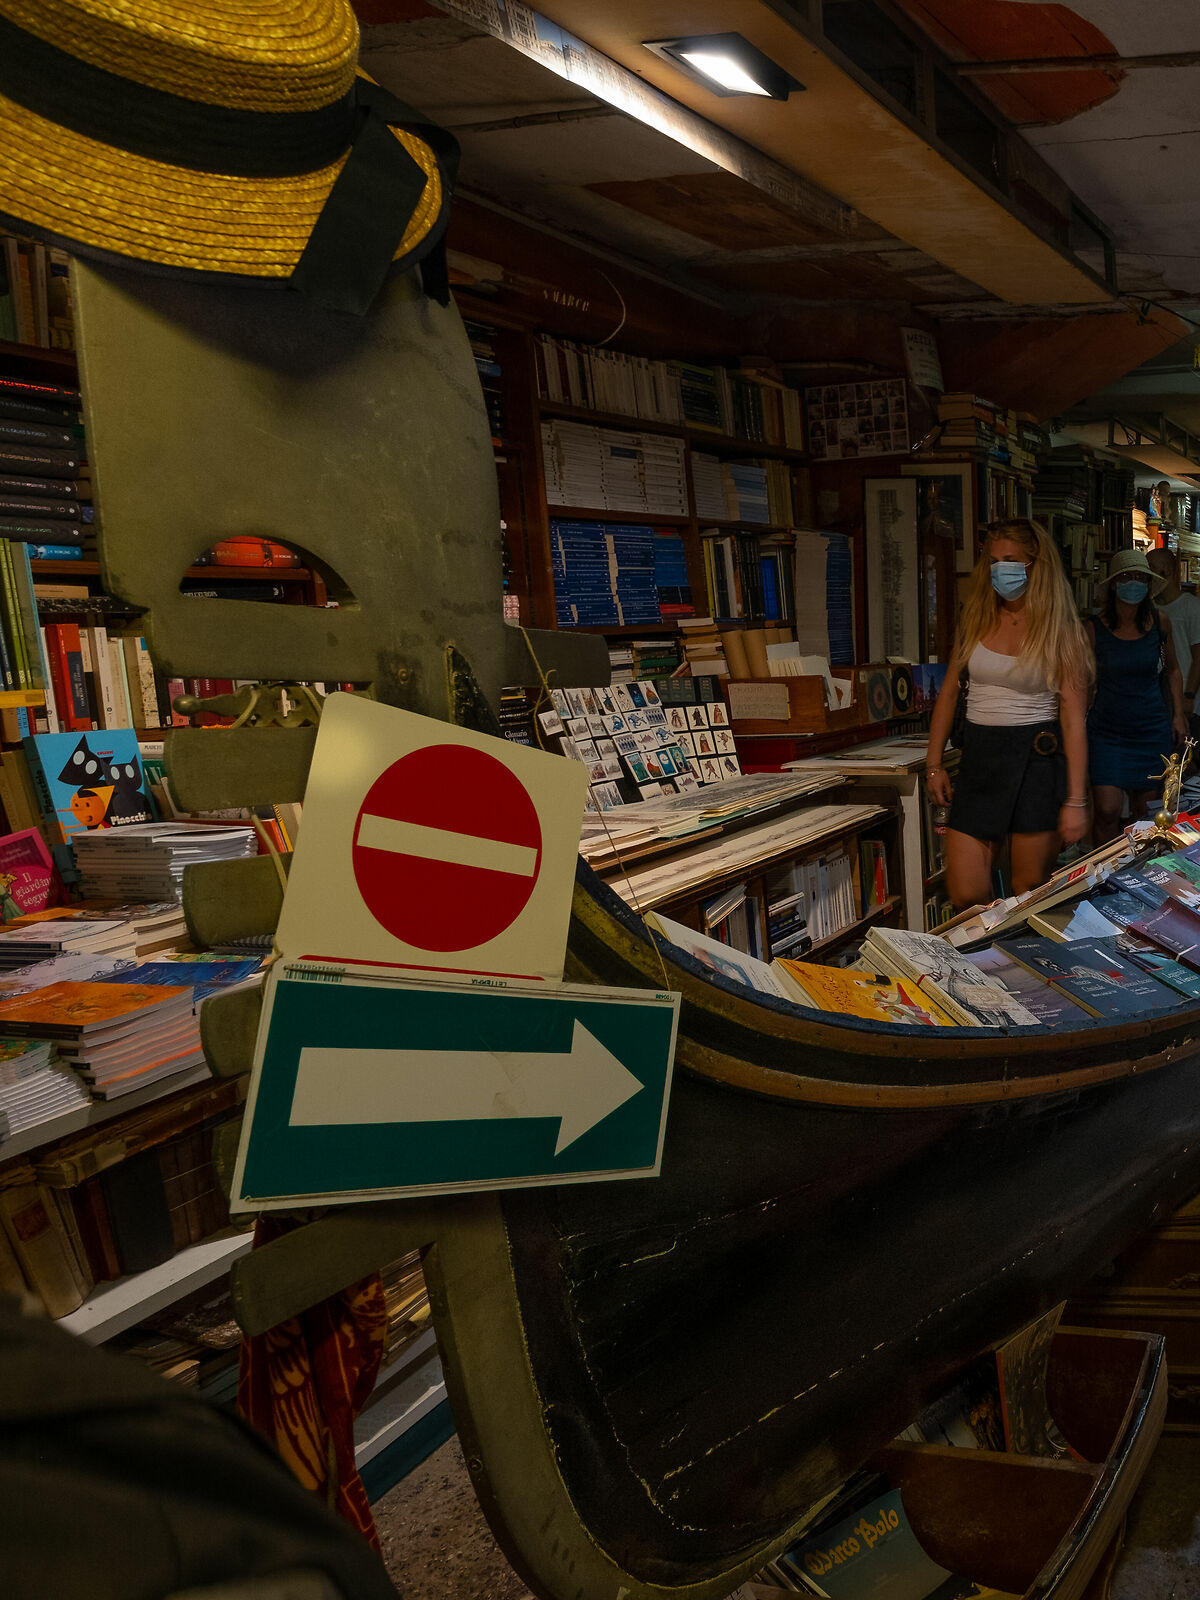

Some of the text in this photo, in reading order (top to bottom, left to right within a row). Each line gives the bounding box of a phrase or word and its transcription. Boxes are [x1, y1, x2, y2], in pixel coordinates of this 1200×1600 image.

[110, 810, 153, 826] Pinocchio
[804, 1507, 900, 1576] Marco Polo
